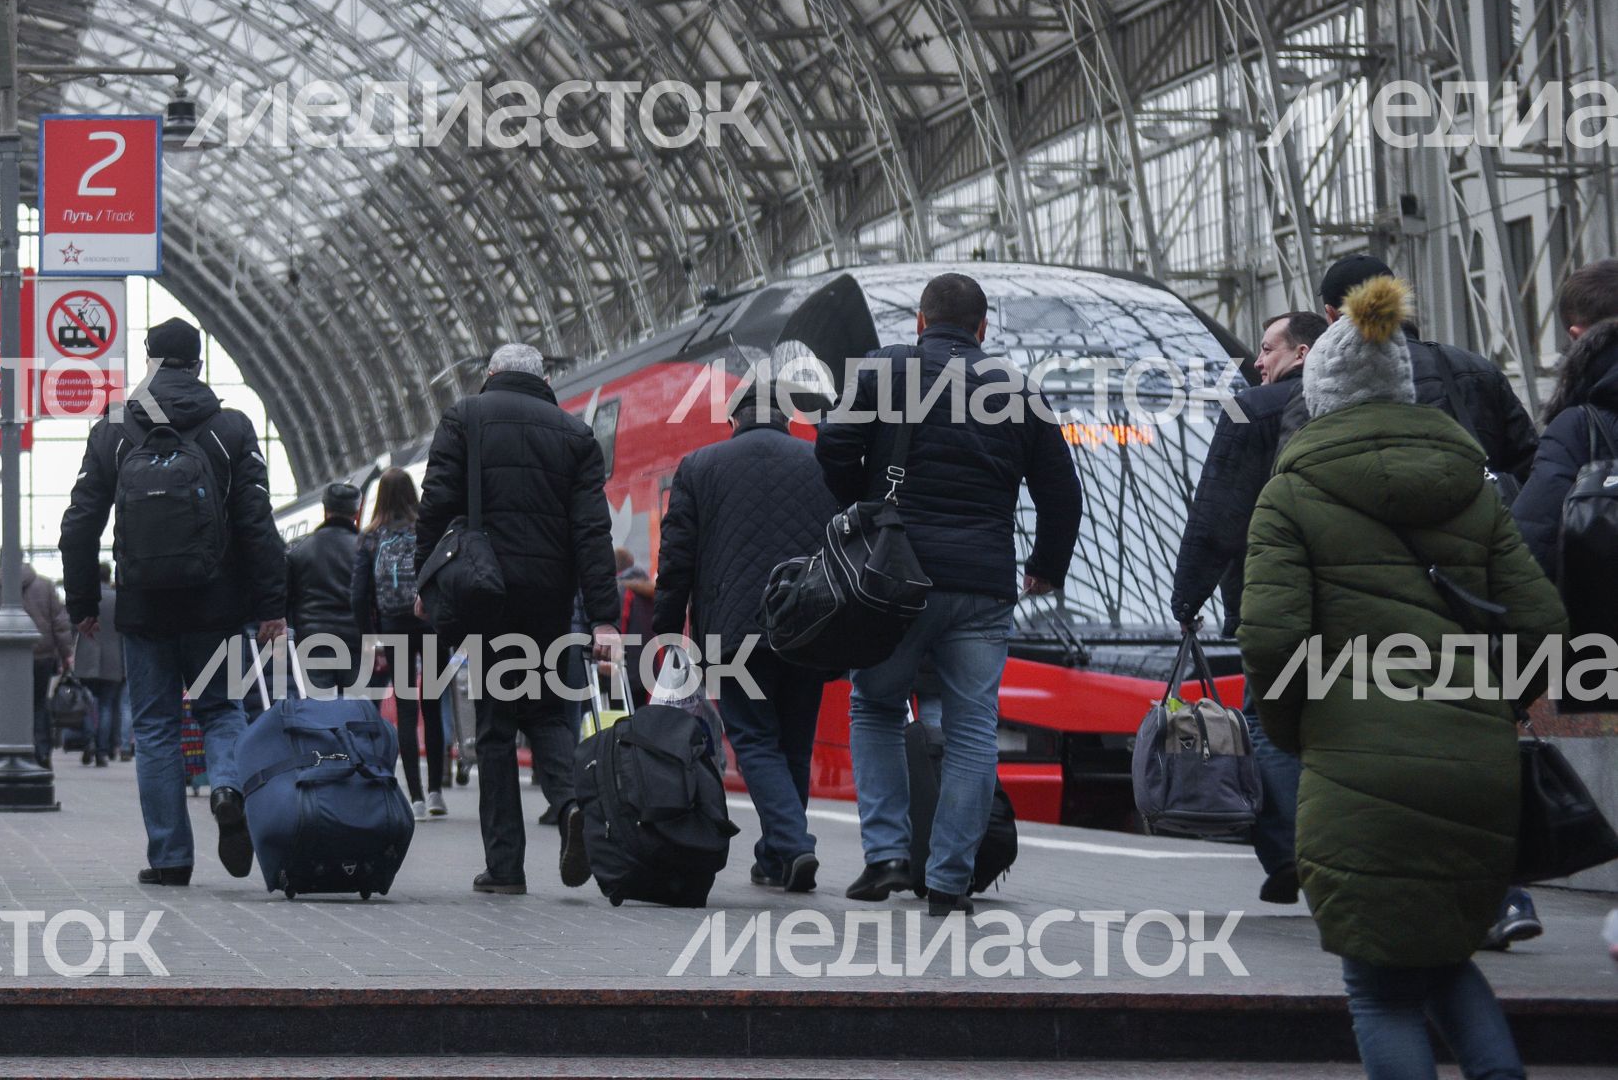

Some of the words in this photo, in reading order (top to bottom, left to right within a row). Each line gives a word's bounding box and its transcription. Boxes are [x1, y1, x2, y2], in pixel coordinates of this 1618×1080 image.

[78, 131, 126, 196] 2
[63, 209, 93, 223] Путь
[106, 209, 135, 221] Track
